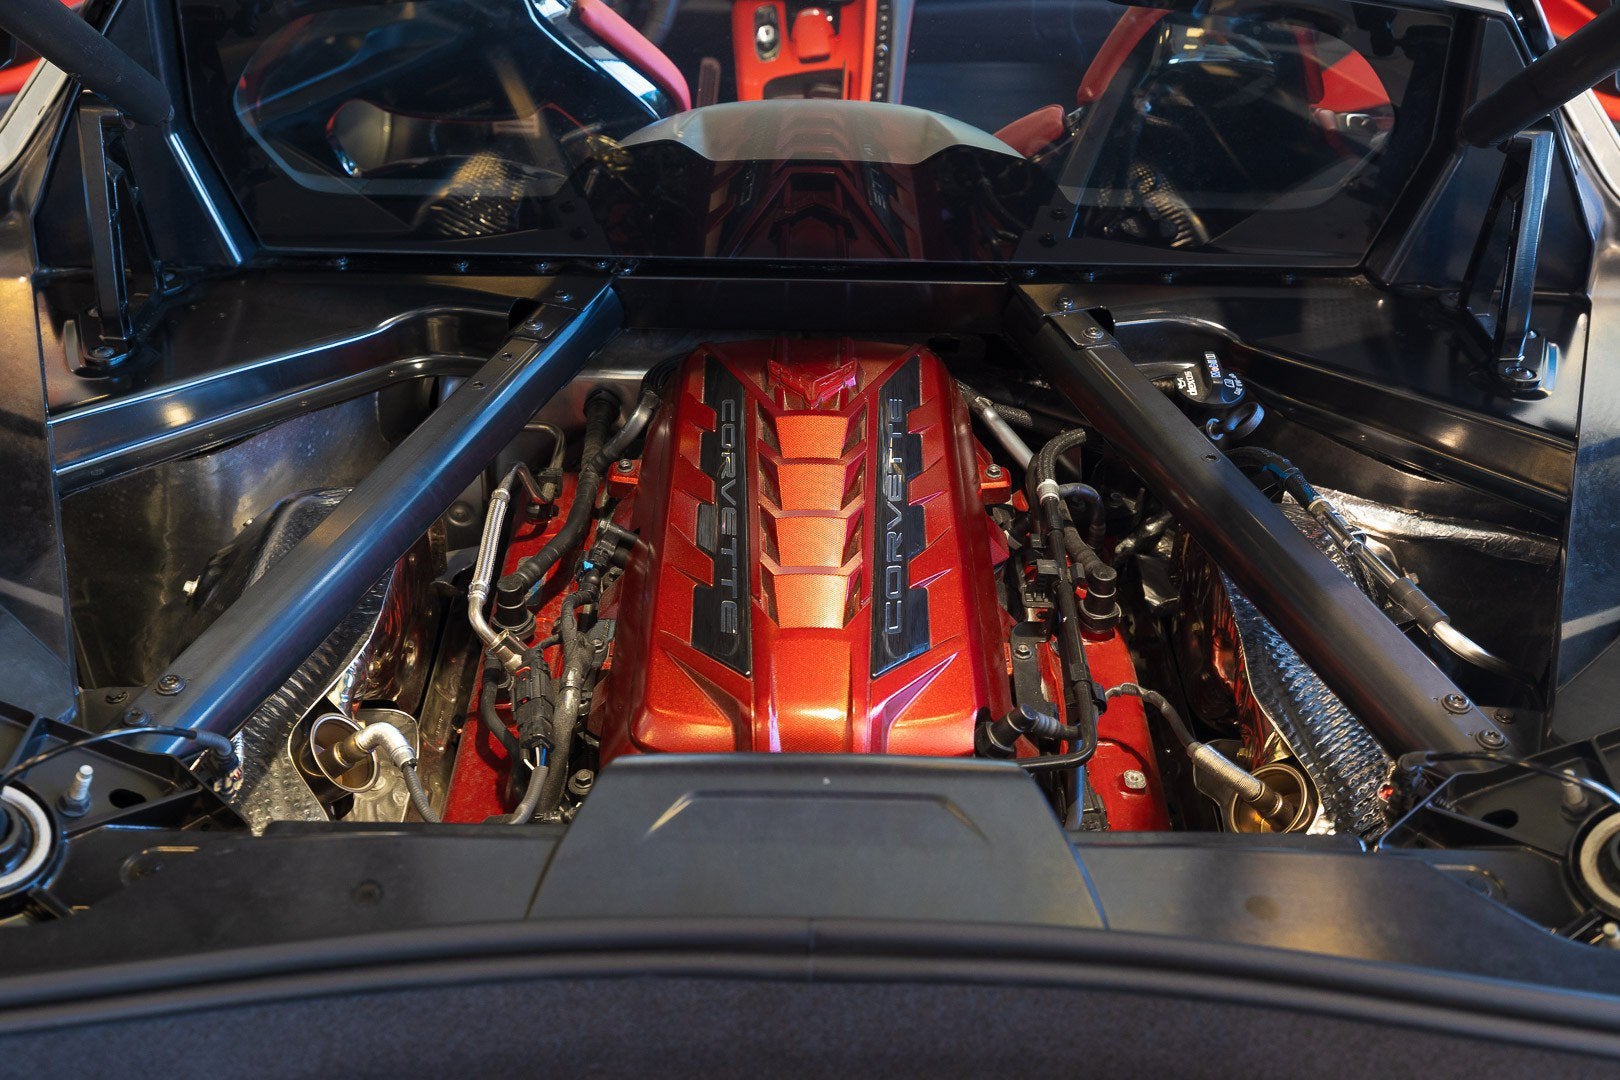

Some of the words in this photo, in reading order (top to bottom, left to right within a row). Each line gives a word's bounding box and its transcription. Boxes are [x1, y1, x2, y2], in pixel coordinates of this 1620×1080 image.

[1184, 370, 1198, 396] dexos
[1207, 360, 1221, 378] Mobil
[721, 399, 738, 634] CORVETTE
[885, 398, 903, 634] CORVETTE
